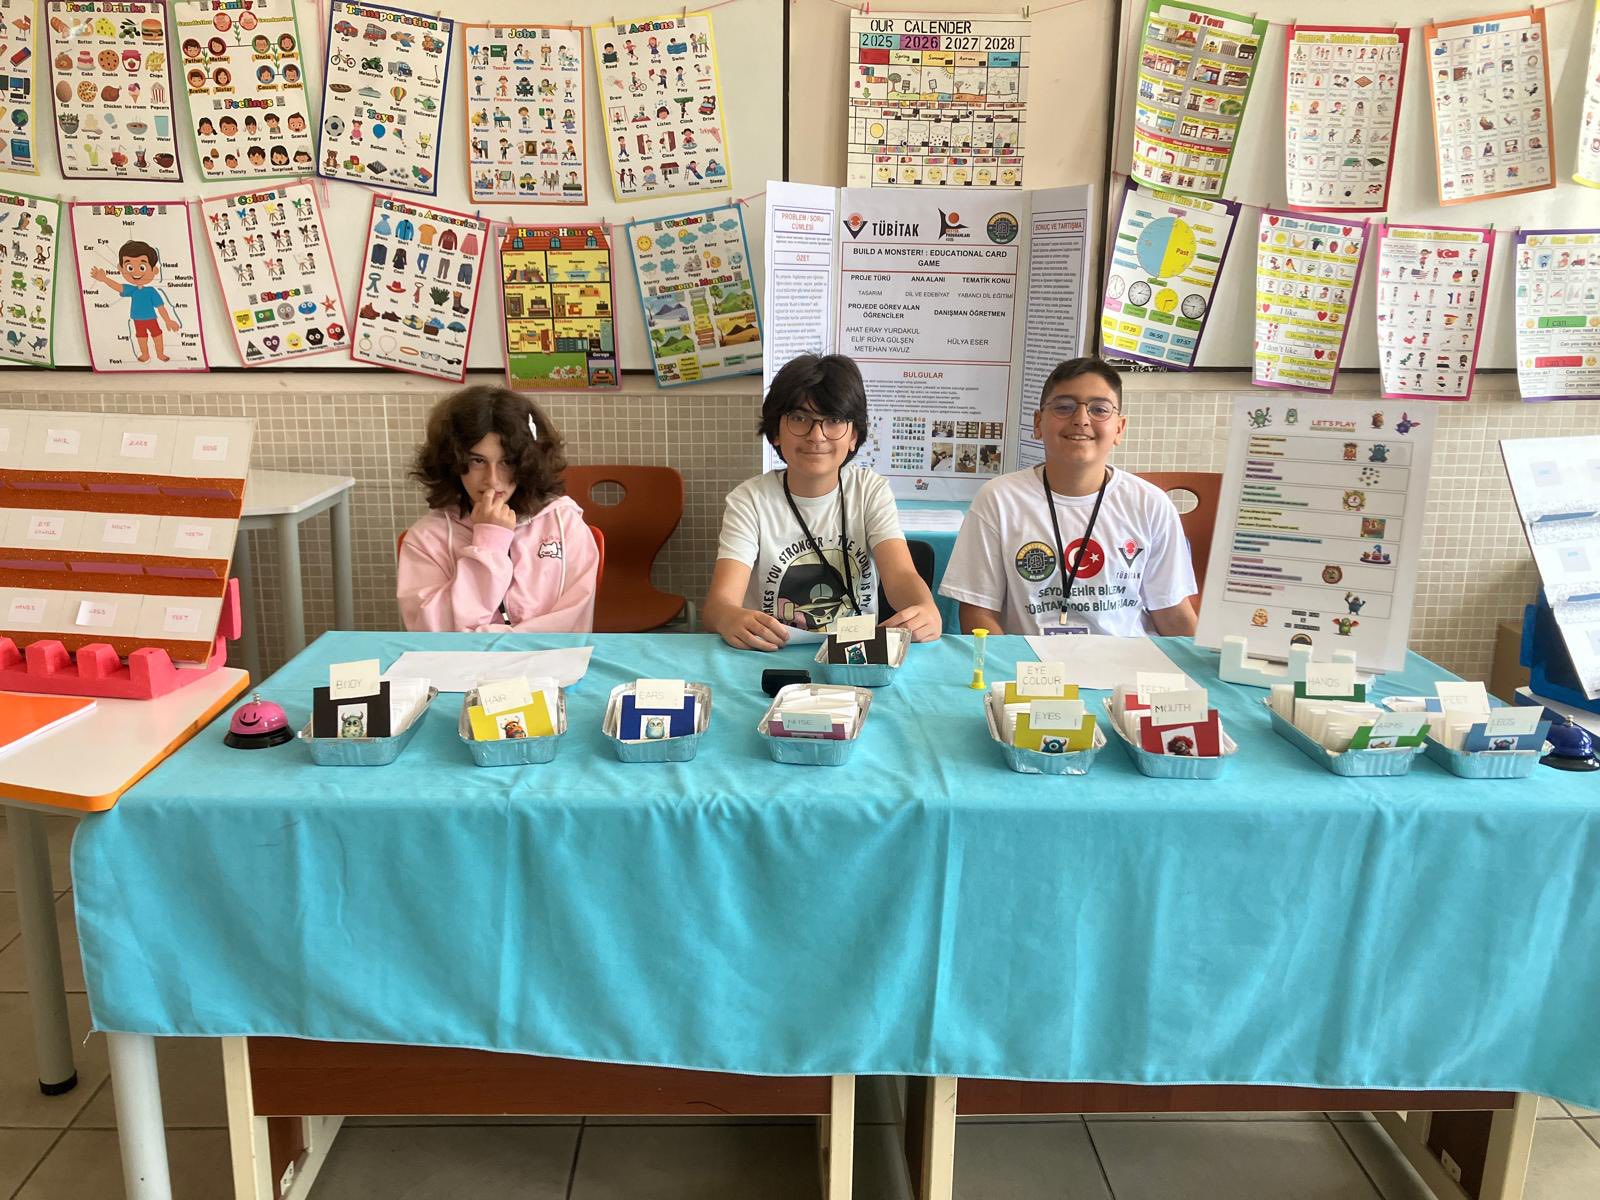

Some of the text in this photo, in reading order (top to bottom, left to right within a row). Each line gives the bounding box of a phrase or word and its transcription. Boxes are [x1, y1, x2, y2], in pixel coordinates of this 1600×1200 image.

[66, 3, 145, 13] Food Drinks
[212, 0, 253, 11] Family
[346, 4, 438, 30] Transportation
[1189, 13, 1201, 24] My
[1202, 16, 1224, 29] Town
[629, 20, 674, 34] Actions
[870, 20, 972, 34] OUR CALENDER
[508, 29, 537, 39] Jobs
[863, 34, 1015, 50] 2025 2026 2027 2028
[224, 98, 274, 110] Feelings
[367, 109, 394, 123] Toys
[0, 195, 25, 207] mals
[238, 192, 276, 206] Colors
[105, 206, 155, 217] My Body
[384, 200, 416, 217] Clothes
[424, 210, 478, 230] Accessories
[782, 213, 807, 221] PROBLEM
[810, 215, 824, 223] SORU
[872, 220, 920, 237] TÜBİTAK
[1058, 221, 1082, 231] TARTIŞMA
[518, 228, 594, 238] Home House
[796, 253, 810, 262] ÖZET
[853, 248, 876, 256] BUILD
[929, 250, 984, 258] EDUCATIONAL
[985, 250, 1007, 258] CARD
[1176, 248, 1190, 256] Past
[874, 274, 891, 282] TÜRÜ
[963, 276, 990, 284] TEMATİK
[260, 289, 301, 302] Shapes
[863, 311, 904, 319] ÖĞRENCİLER
[934, 309, 1006, 318] DANIŞMAN ÖĞRETMEN
[867, 336, 885, 344] RÜYA
[886, 337, 914, 345] GÜLŞEN
[947, 338, 969, 346] HÜLYA
[903, 371, 944, 379] BULGULAR
[838, 535, 855, 551] TE
[779, 536, 823, 564] STRONGR
[855, 547, 871, 580] WORLD
[766, 565, 782, 584] YOU
[1116, 571, 1141, 580] TÜBAK
[861, 582, 871, 591] IS
[1038, 584, 1095, 598] SEYDŞEHİR
[762, 590, 775, 617] AKES
[861, 594, 872, 608] MY
[1093, 600, 1116, 612] BİLİM
[1027, 666, 1046, 675] EYE
[336, 679, 362, 690] BODY
[1022, 676, 1062, 686] COLOUR
[1308, 677, 1340, 688] HANDS
[1154, 704, 1192, 713] MOUTH
[1035, 711, 1062, 722] EYES
